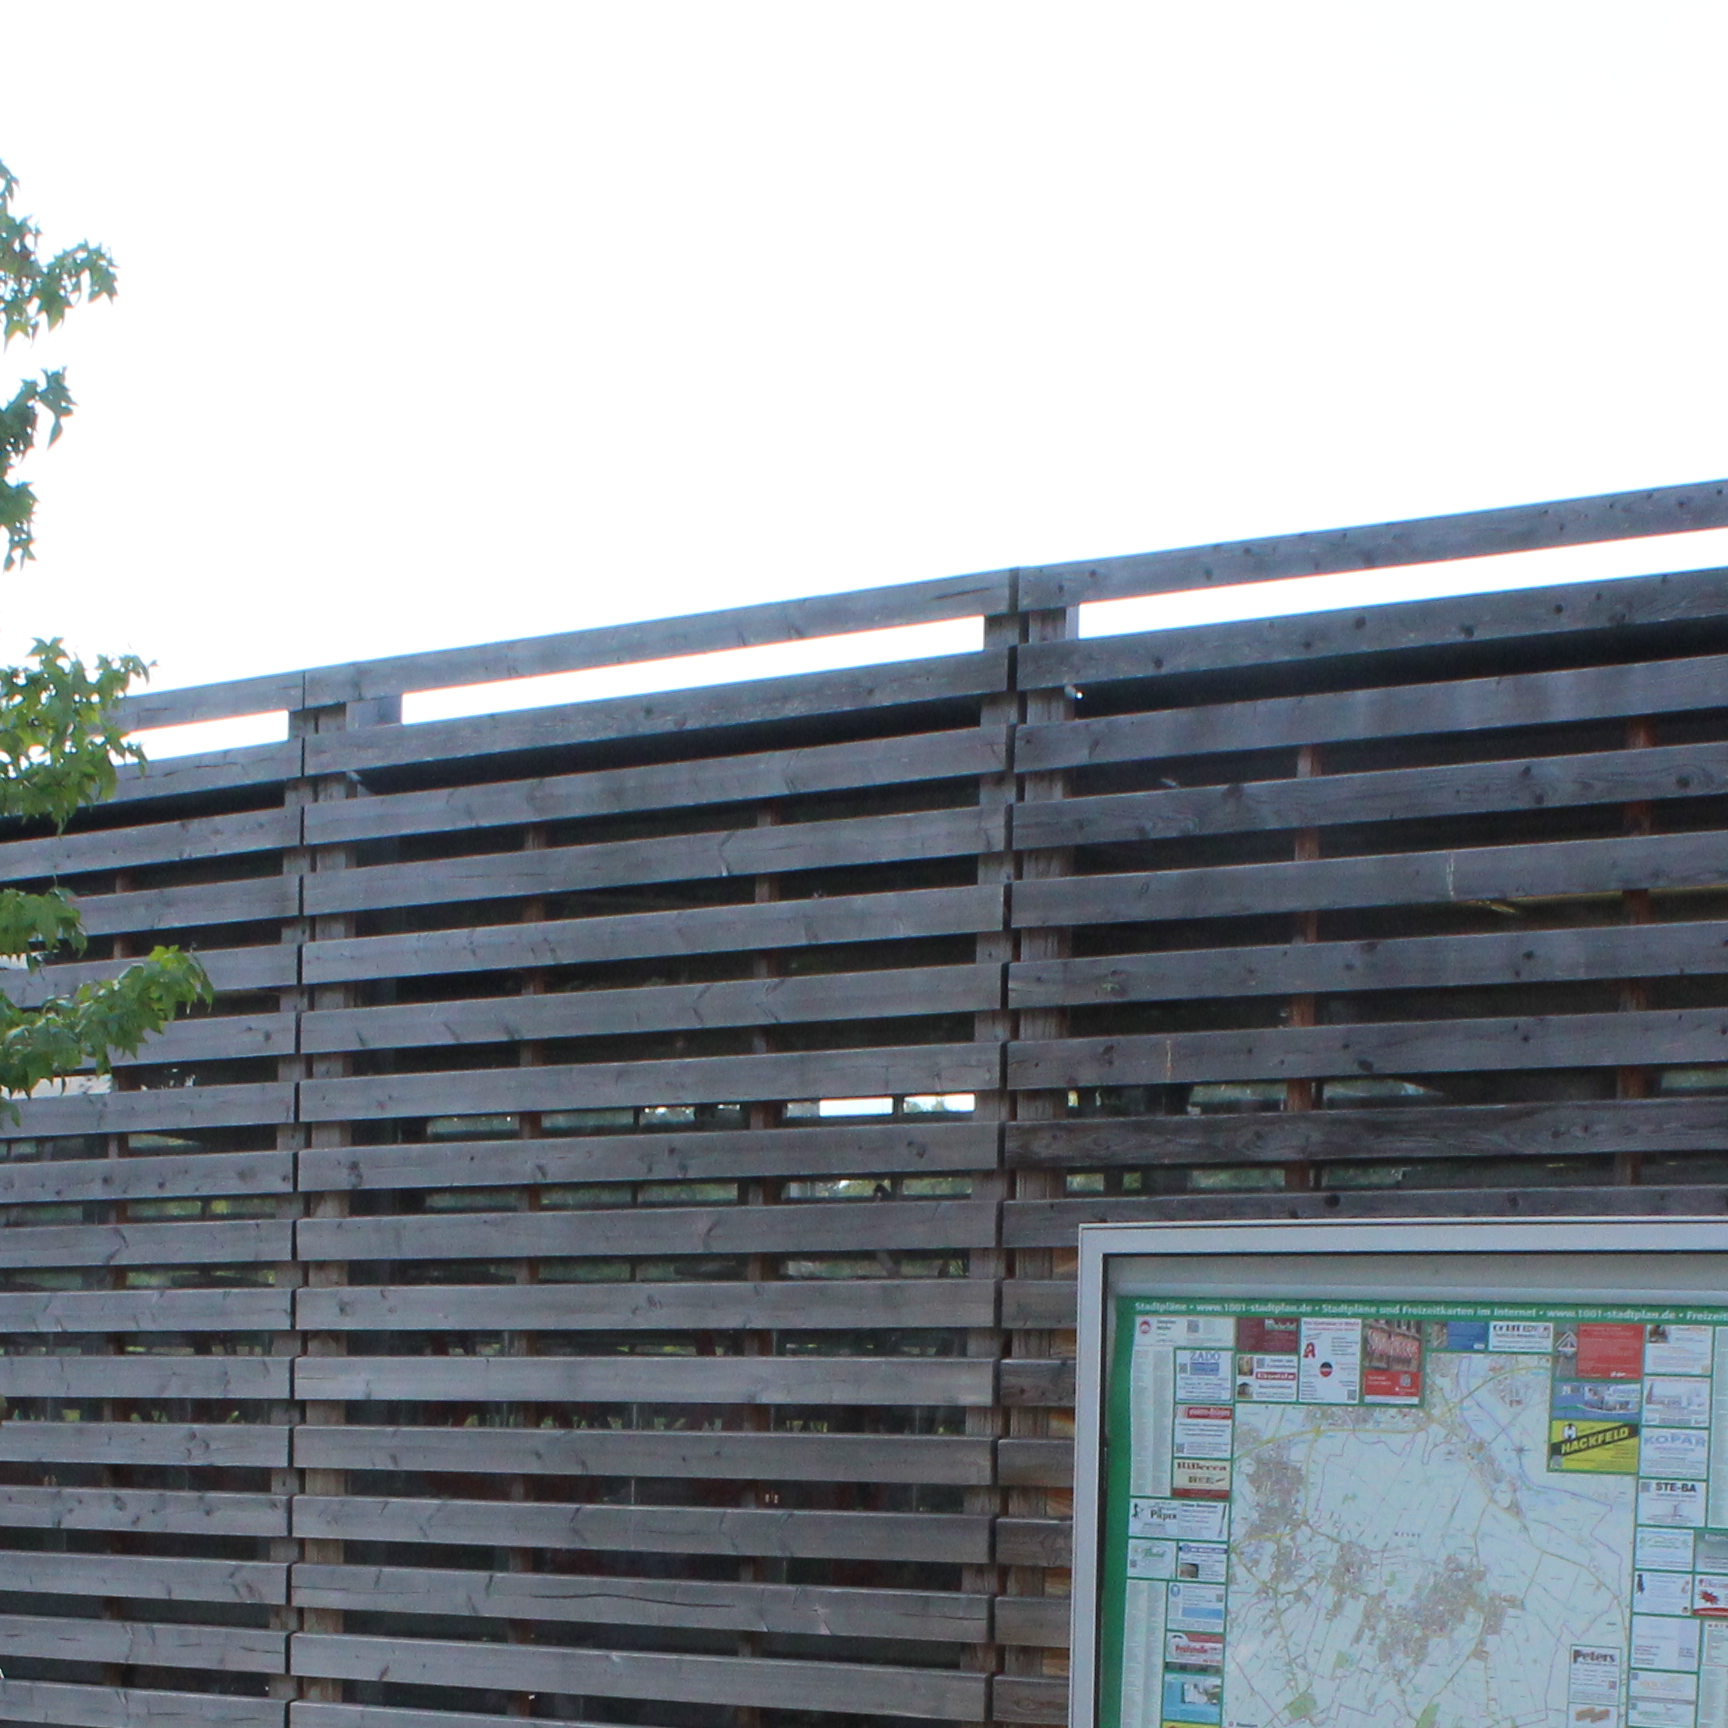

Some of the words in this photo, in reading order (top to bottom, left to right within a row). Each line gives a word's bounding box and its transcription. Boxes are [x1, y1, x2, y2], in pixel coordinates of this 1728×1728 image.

[1379, 1305, 1400, 1314] und
[1402, 1305, 1474, 1315] Freizeitkarten
[1493, 1307, 1536, 1316] Internet
[1561, 1427, 1630, 1454] HACKFELD
[1655, 1482, 1697, 1493] STE-BA
